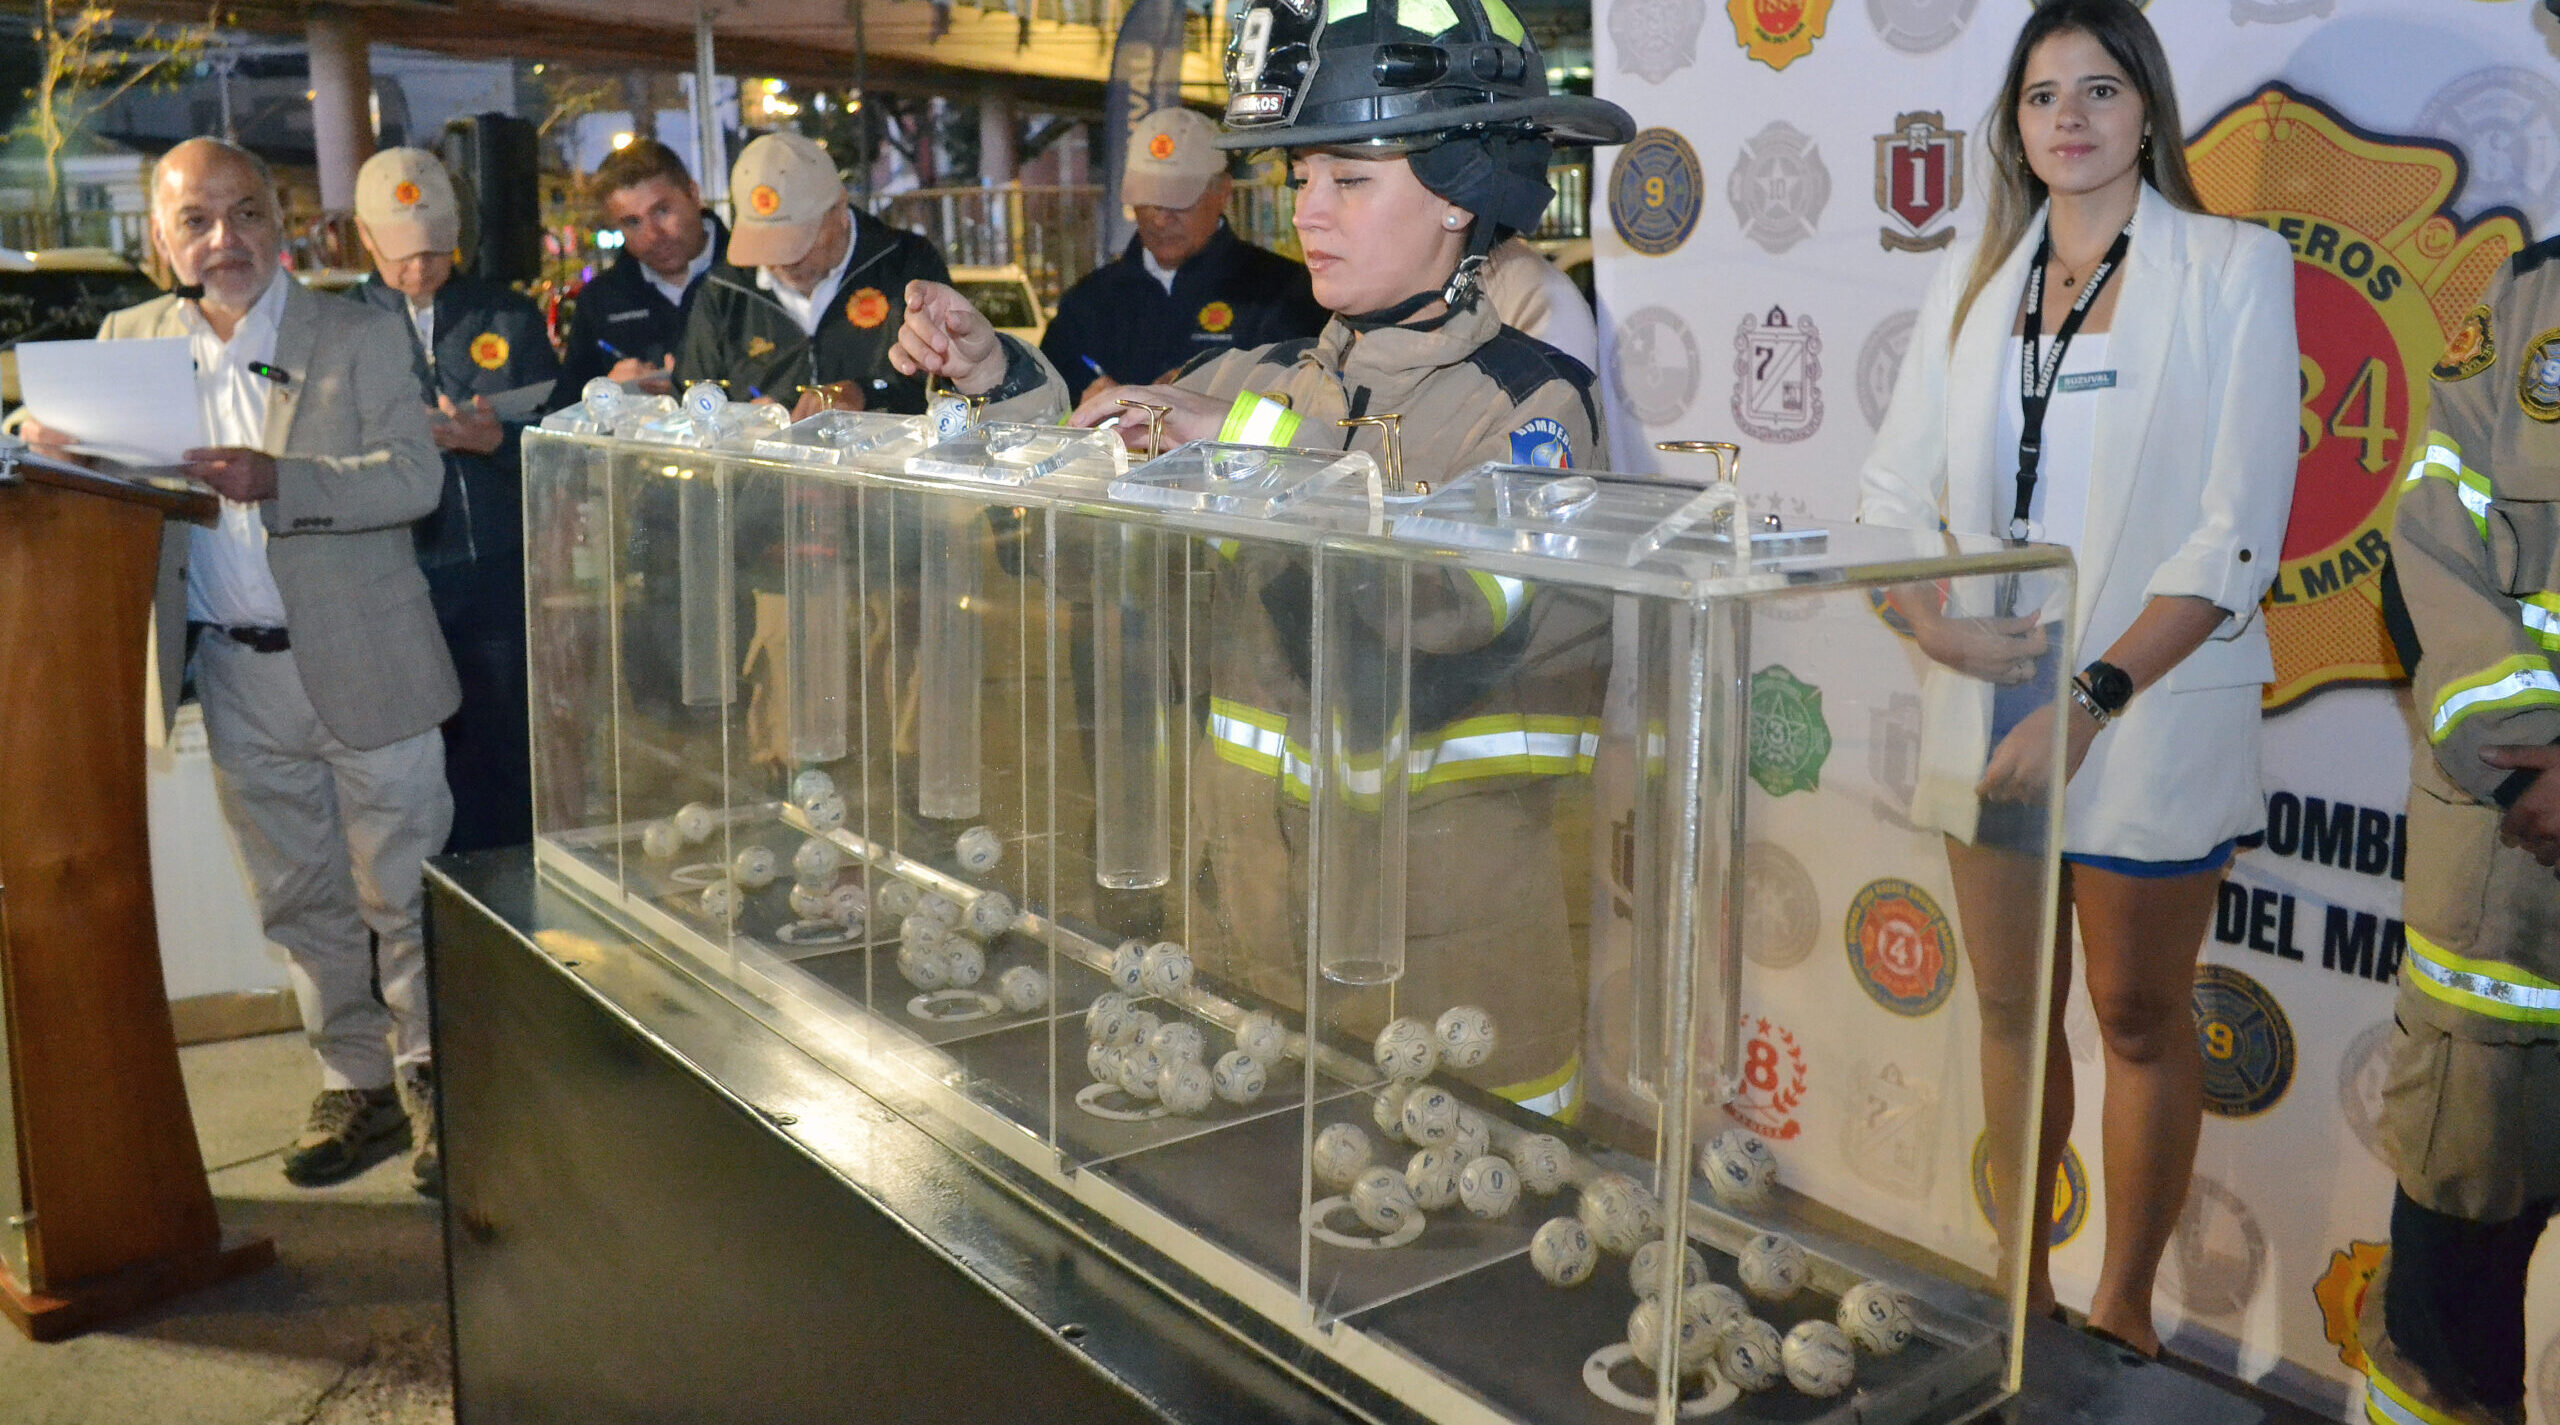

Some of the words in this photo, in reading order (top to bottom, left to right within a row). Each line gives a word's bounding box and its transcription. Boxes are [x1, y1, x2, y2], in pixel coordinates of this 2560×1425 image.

[1645, 176, 1665, 207] 9
[1768, 178, 1786, 200] 10
[1909, 157, 1930, 207] 1
[2070, 262, 2112, 312] SUZUVAL
[1755, 346, 1774, 381] 7
[2022, 340, 2035, 398] SUZUVAL
[2034, 340, 2065, 398] SUZUVAL
[2064, 374, 2110, 386] SUZUVAL
[700, 398, 711, 411] 0
[939, 418, 949, 432] 3
[2299, 528, 2390, 599] MAR
[1768, 720, 1785, 743] 3
[2216, 879, 2304, 963] DEL
[2322, 903, 2408, 987] MA
[1889, 935, 1909, 966] 4
[1412, 1043, 1428, 1065] 2
[2204, 1021, 2234, 1060] 9
[1744, 1039, 1779, 1092] 8
[1491, 1169, 1503, 1190] 0
[1868, 1301, 1886, 1322] 5
